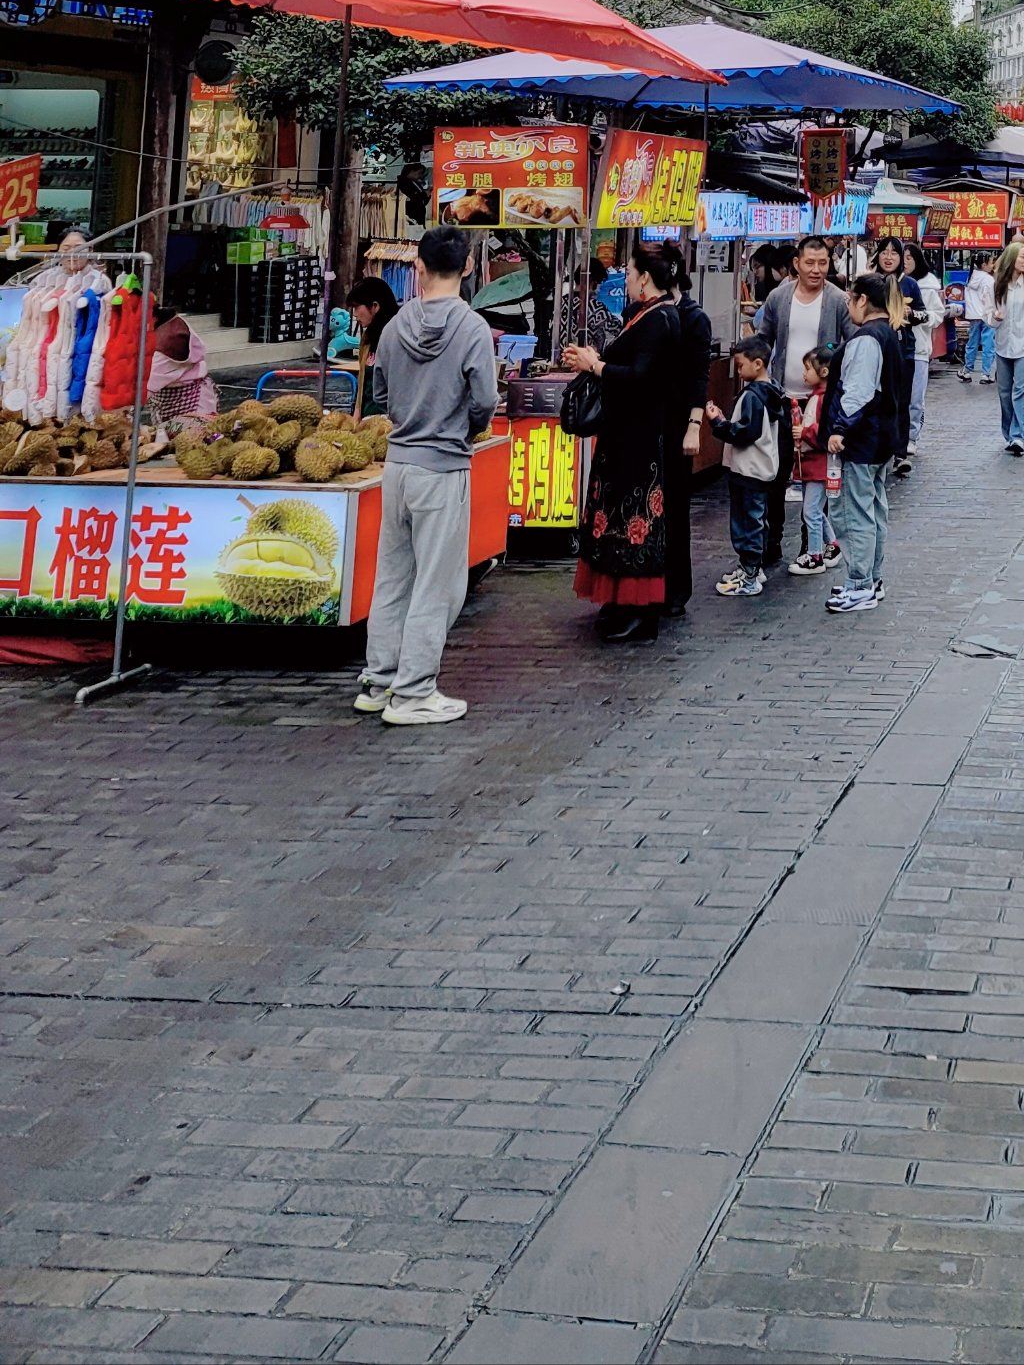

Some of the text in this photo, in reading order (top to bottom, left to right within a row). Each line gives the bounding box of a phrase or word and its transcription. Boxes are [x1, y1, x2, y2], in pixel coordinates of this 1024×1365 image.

[453, 132, 579, 161] 新奥尔良
[445, 172, 574, 188] 鸡腿 烤翅
[645, 141, 704, 224] 烤鸡腿
[2, 172, 35, 220] 25
[879, 226, 913, 238] 烤面筋
